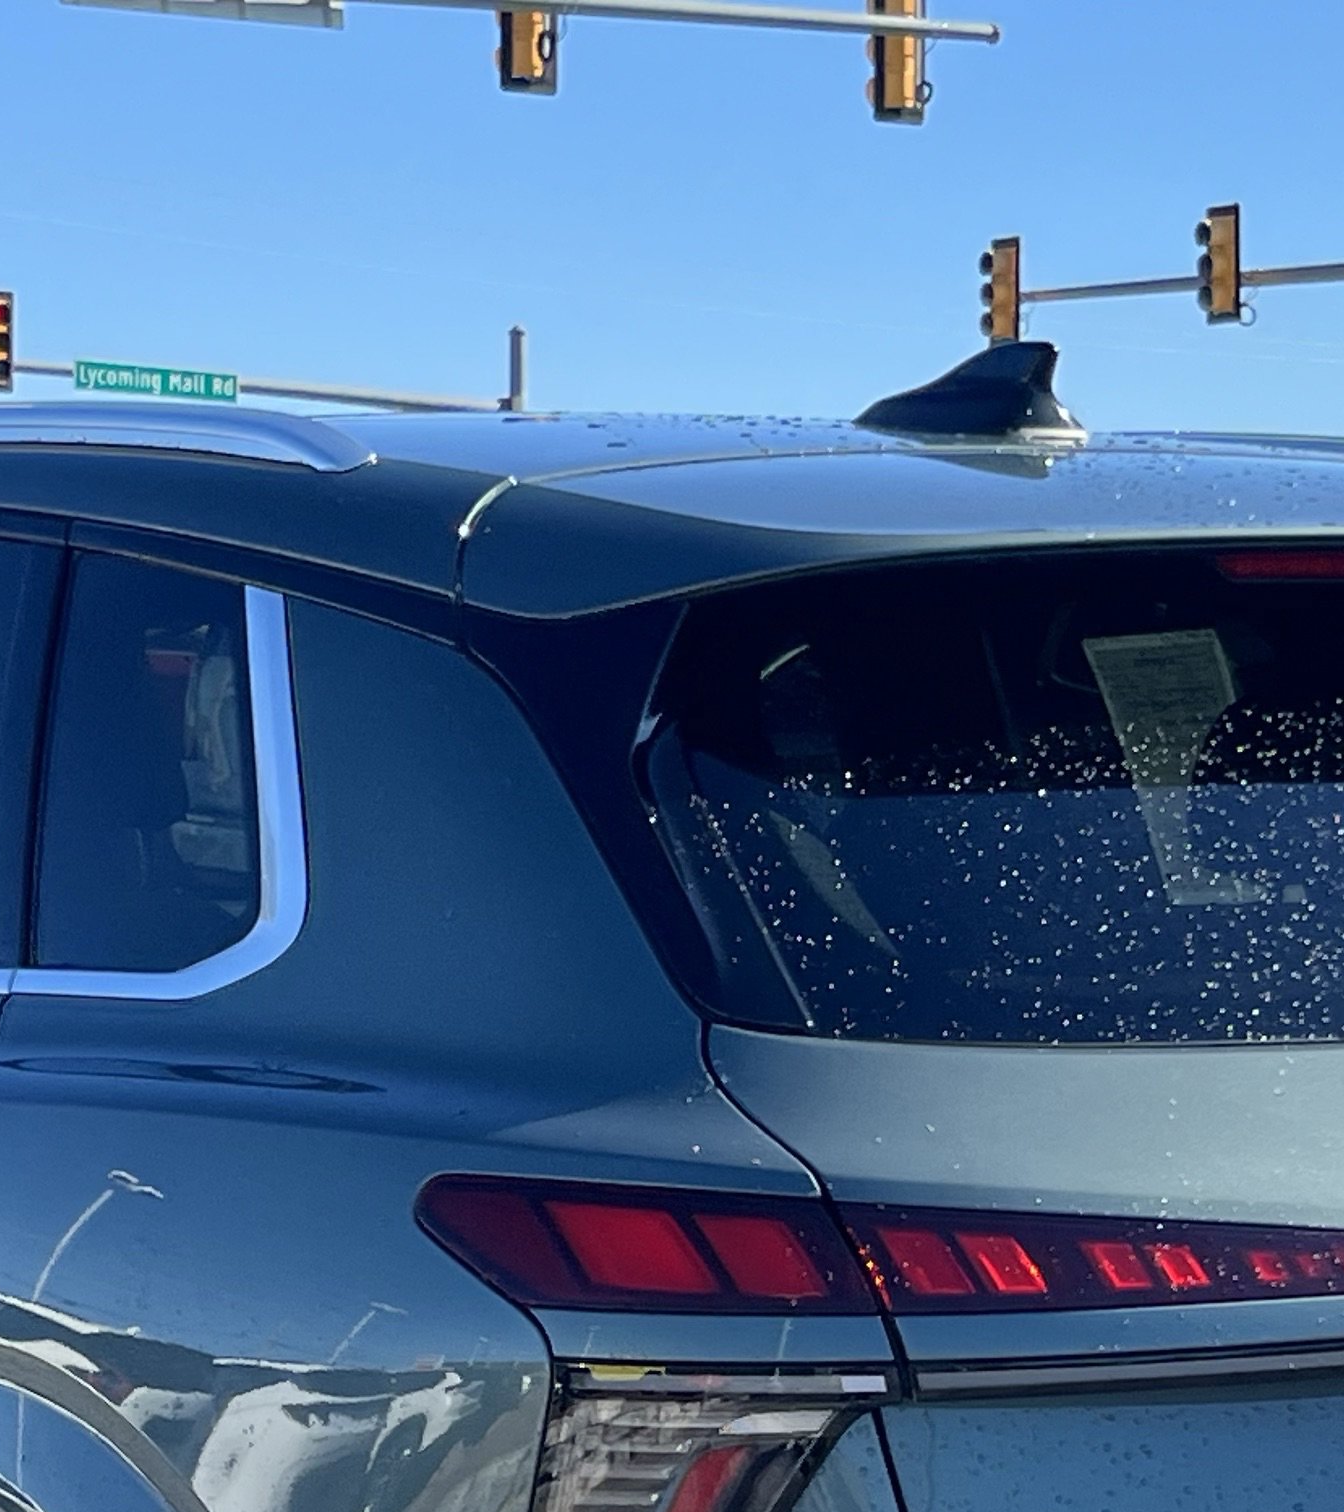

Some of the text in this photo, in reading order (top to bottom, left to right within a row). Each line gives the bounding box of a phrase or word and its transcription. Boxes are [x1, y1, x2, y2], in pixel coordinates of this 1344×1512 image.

[79, 364, 234, 397] Lycoming Mall Rd
